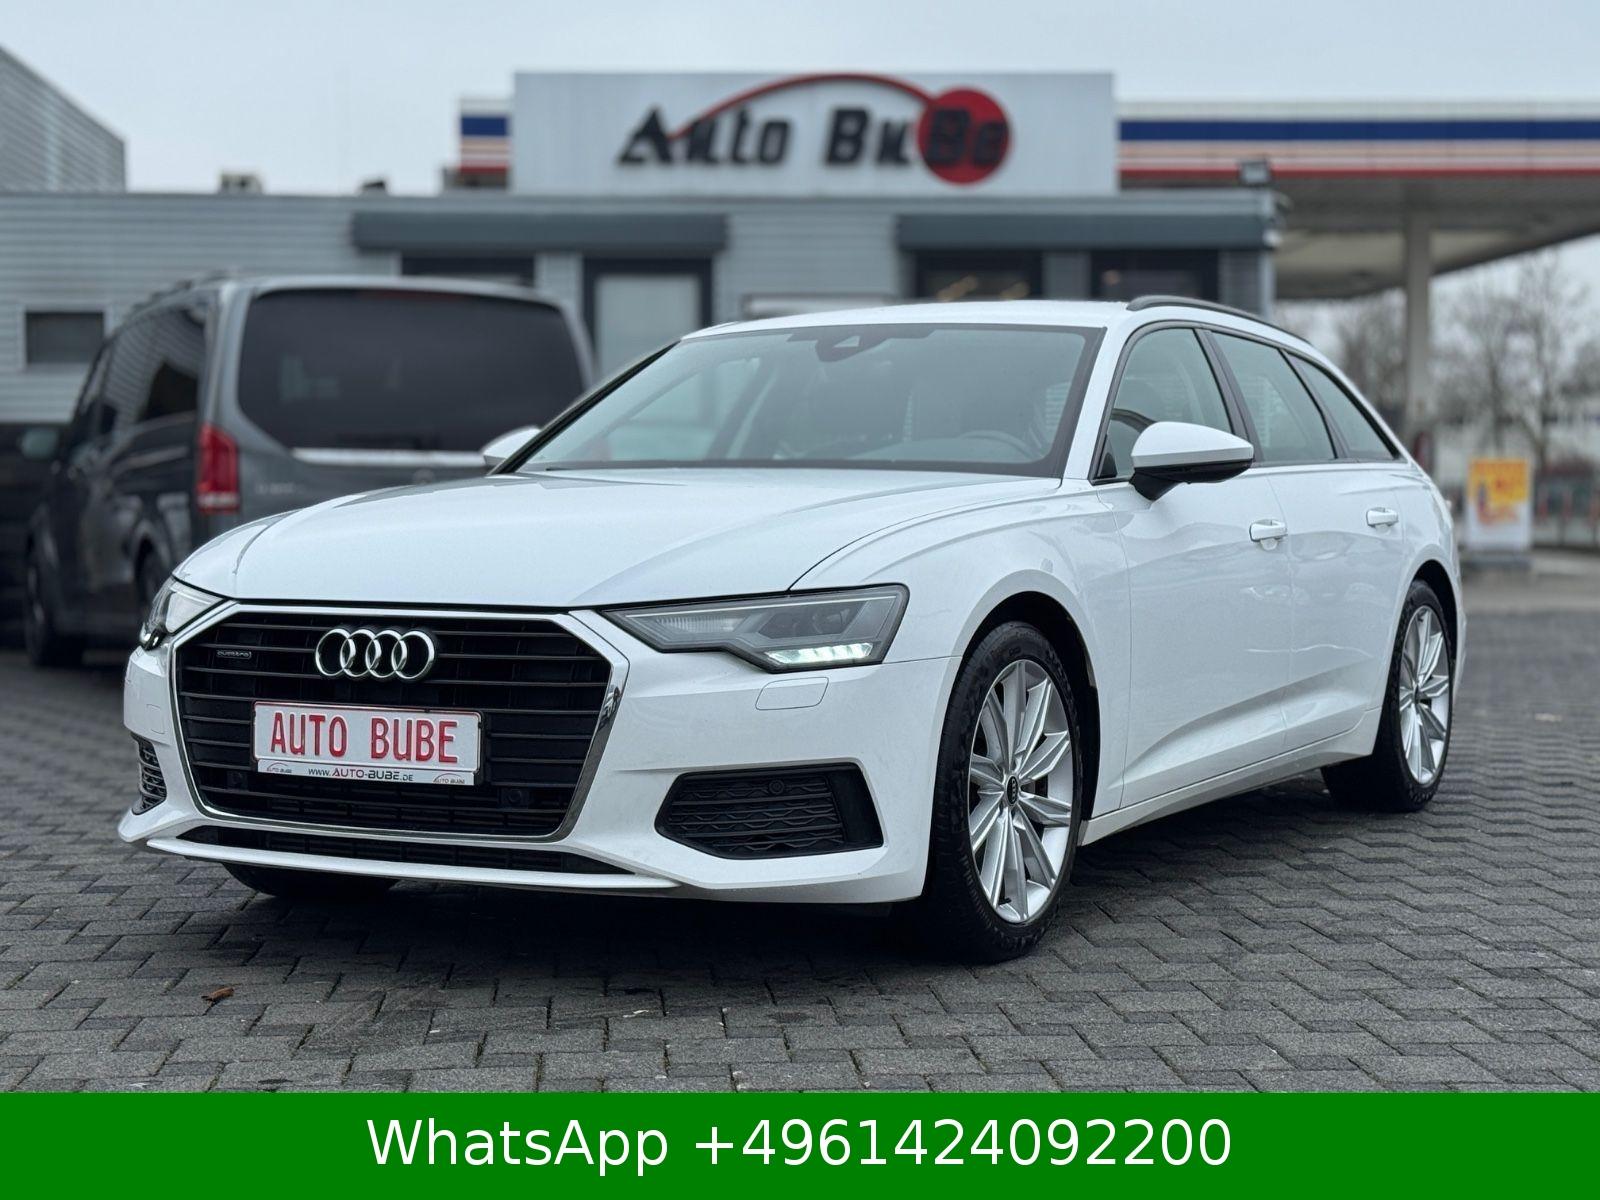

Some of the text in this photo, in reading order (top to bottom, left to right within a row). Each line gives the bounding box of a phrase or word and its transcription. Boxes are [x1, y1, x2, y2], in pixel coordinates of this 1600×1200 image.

[618, 105, 791, 165] Auto
[270, 712, 458, 763] AUTO BUBE
